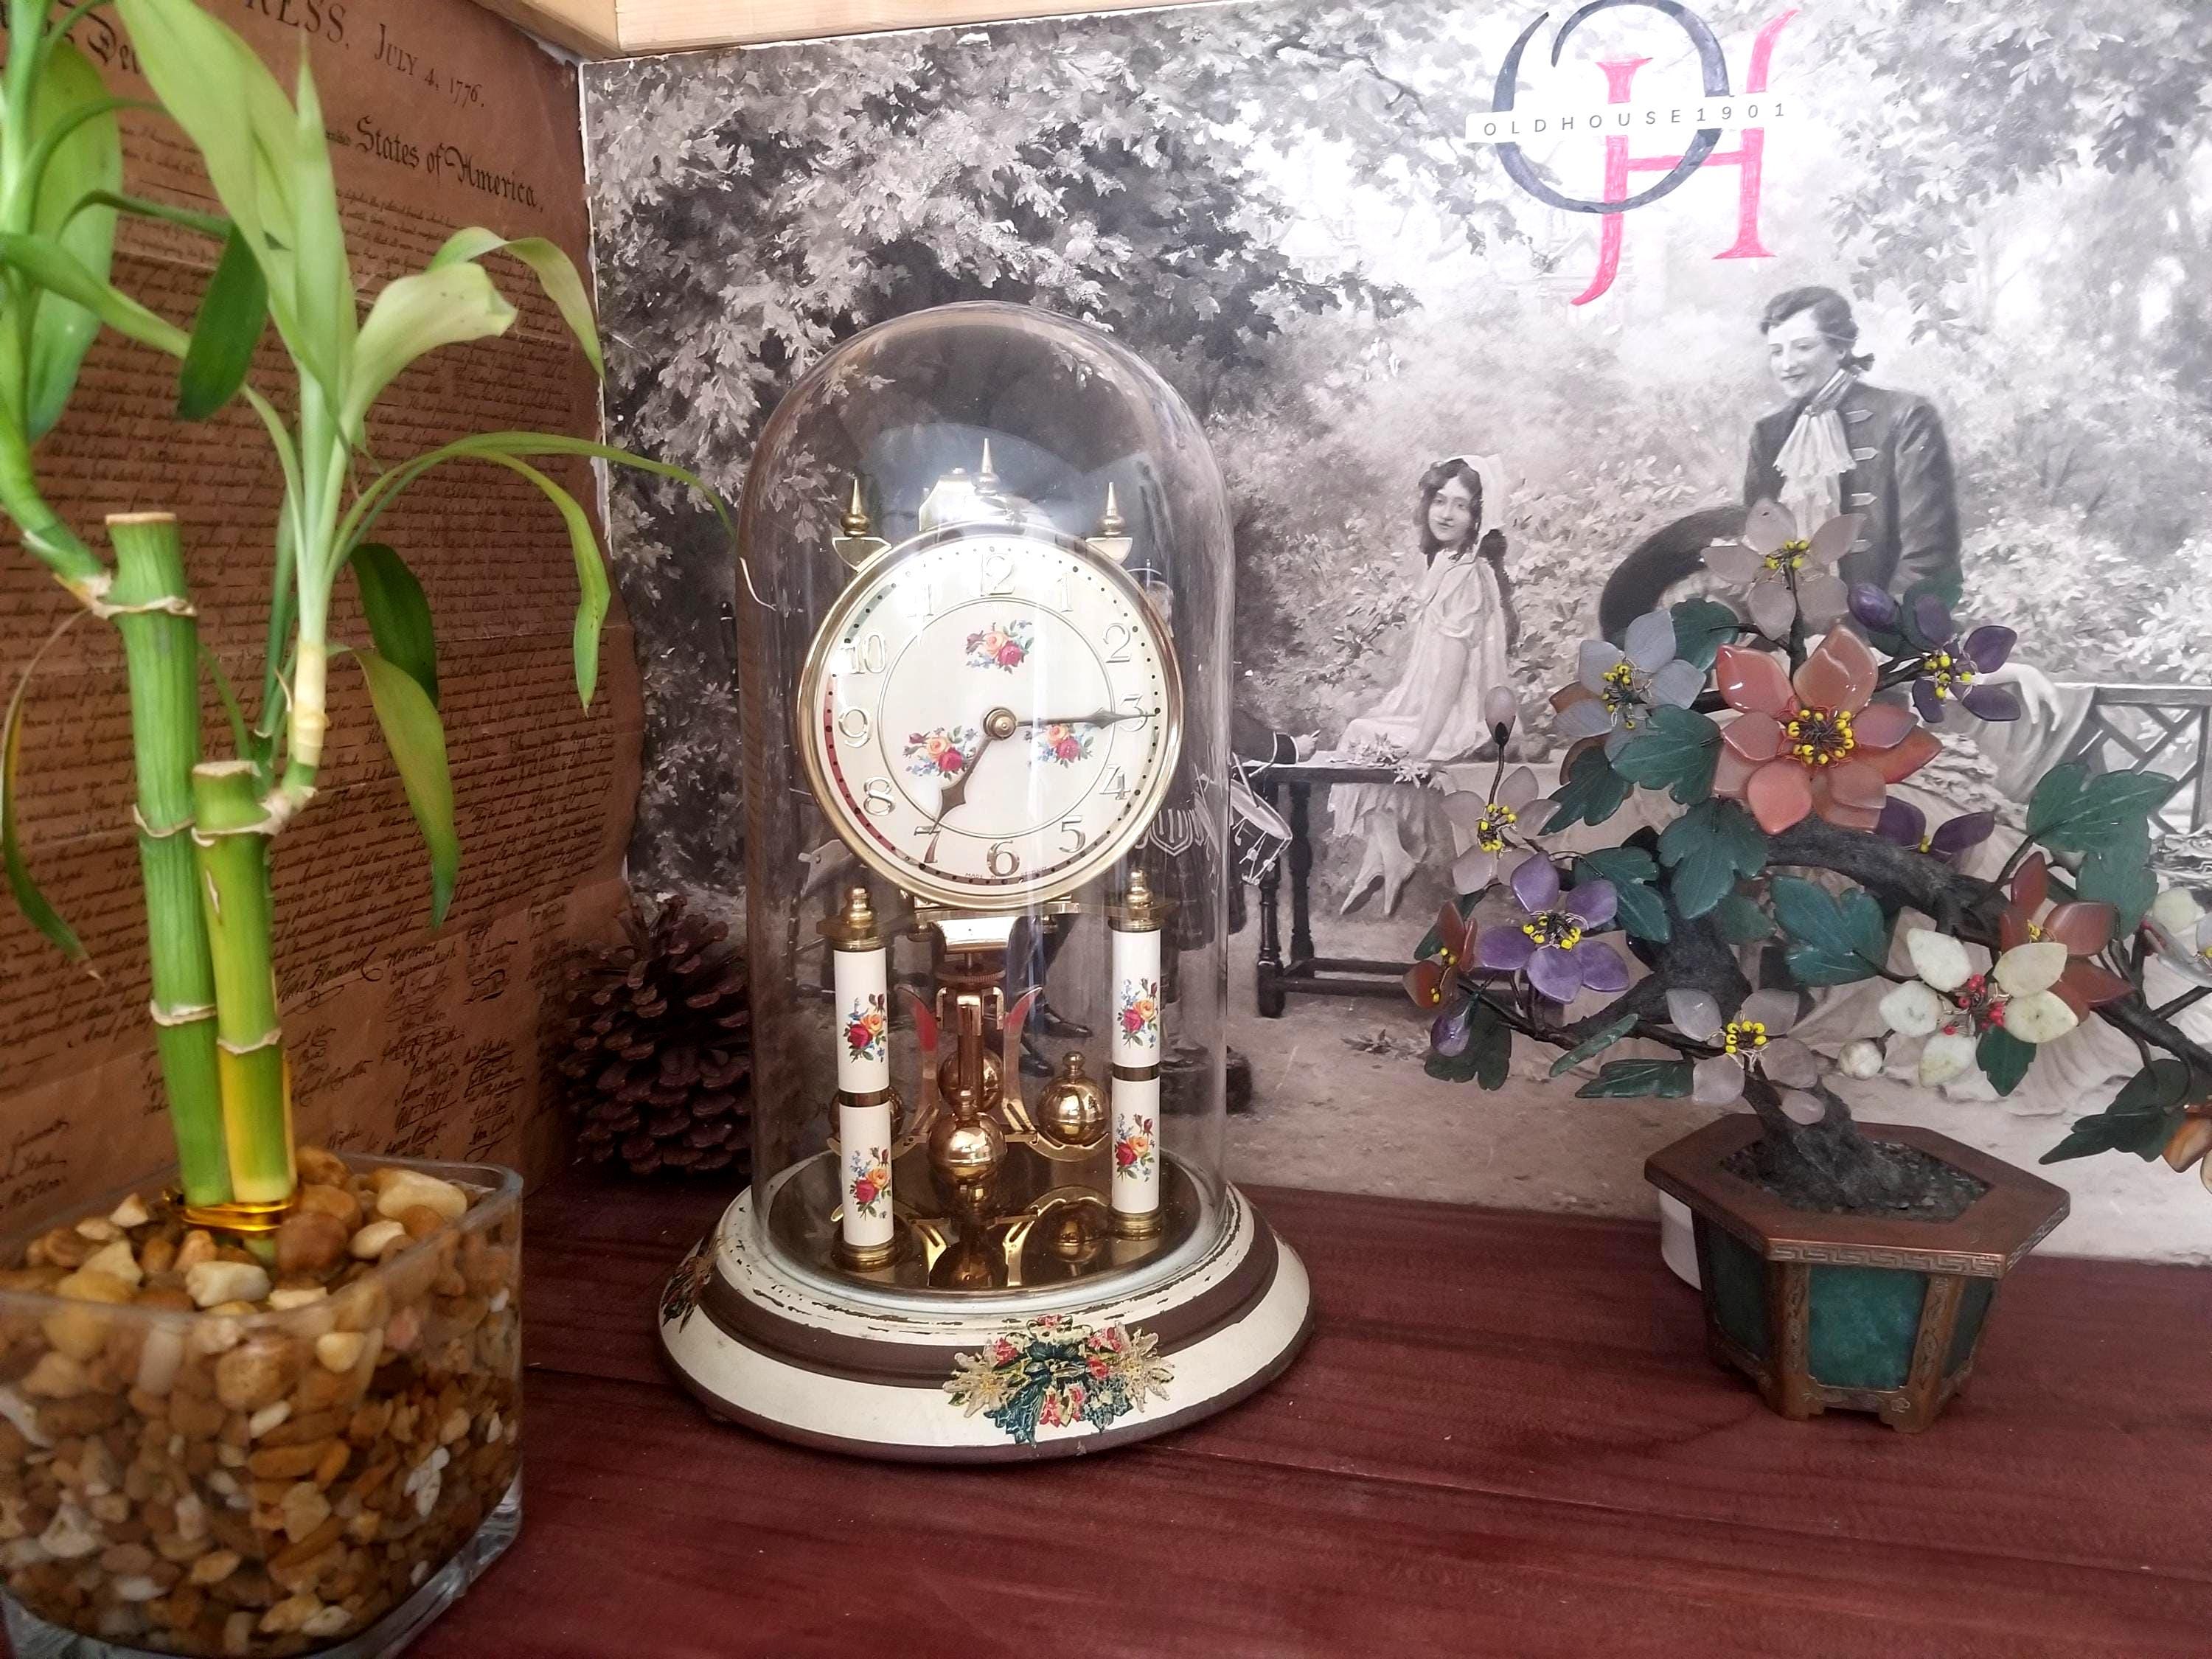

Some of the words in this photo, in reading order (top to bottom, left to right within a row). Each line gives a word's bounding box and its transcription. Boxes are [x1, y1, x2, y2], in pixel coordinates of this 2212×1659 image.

[450, 78, 484, 108] 1776.
[355, 116, 420, 168] States
[427, 143, 442, 183] of
[445, 145, 544, 212] America,
[981, 552, 1015, 596] 12
[1057, 577, 1074, 612] 1
[840, 633, 888, 674] 10
[1102, 624, 1130, 663] 2
[839, 707, 872, 748] 9
[1119, 694, 1147, 731] 3
[863, 776, 895, 816] 8
[1099, 764, 1130, 799] 4
[914, 826, 940, 863] 7
[1060, 815, 1085, 852] 5
[986, 840, 1020, 877] 6
